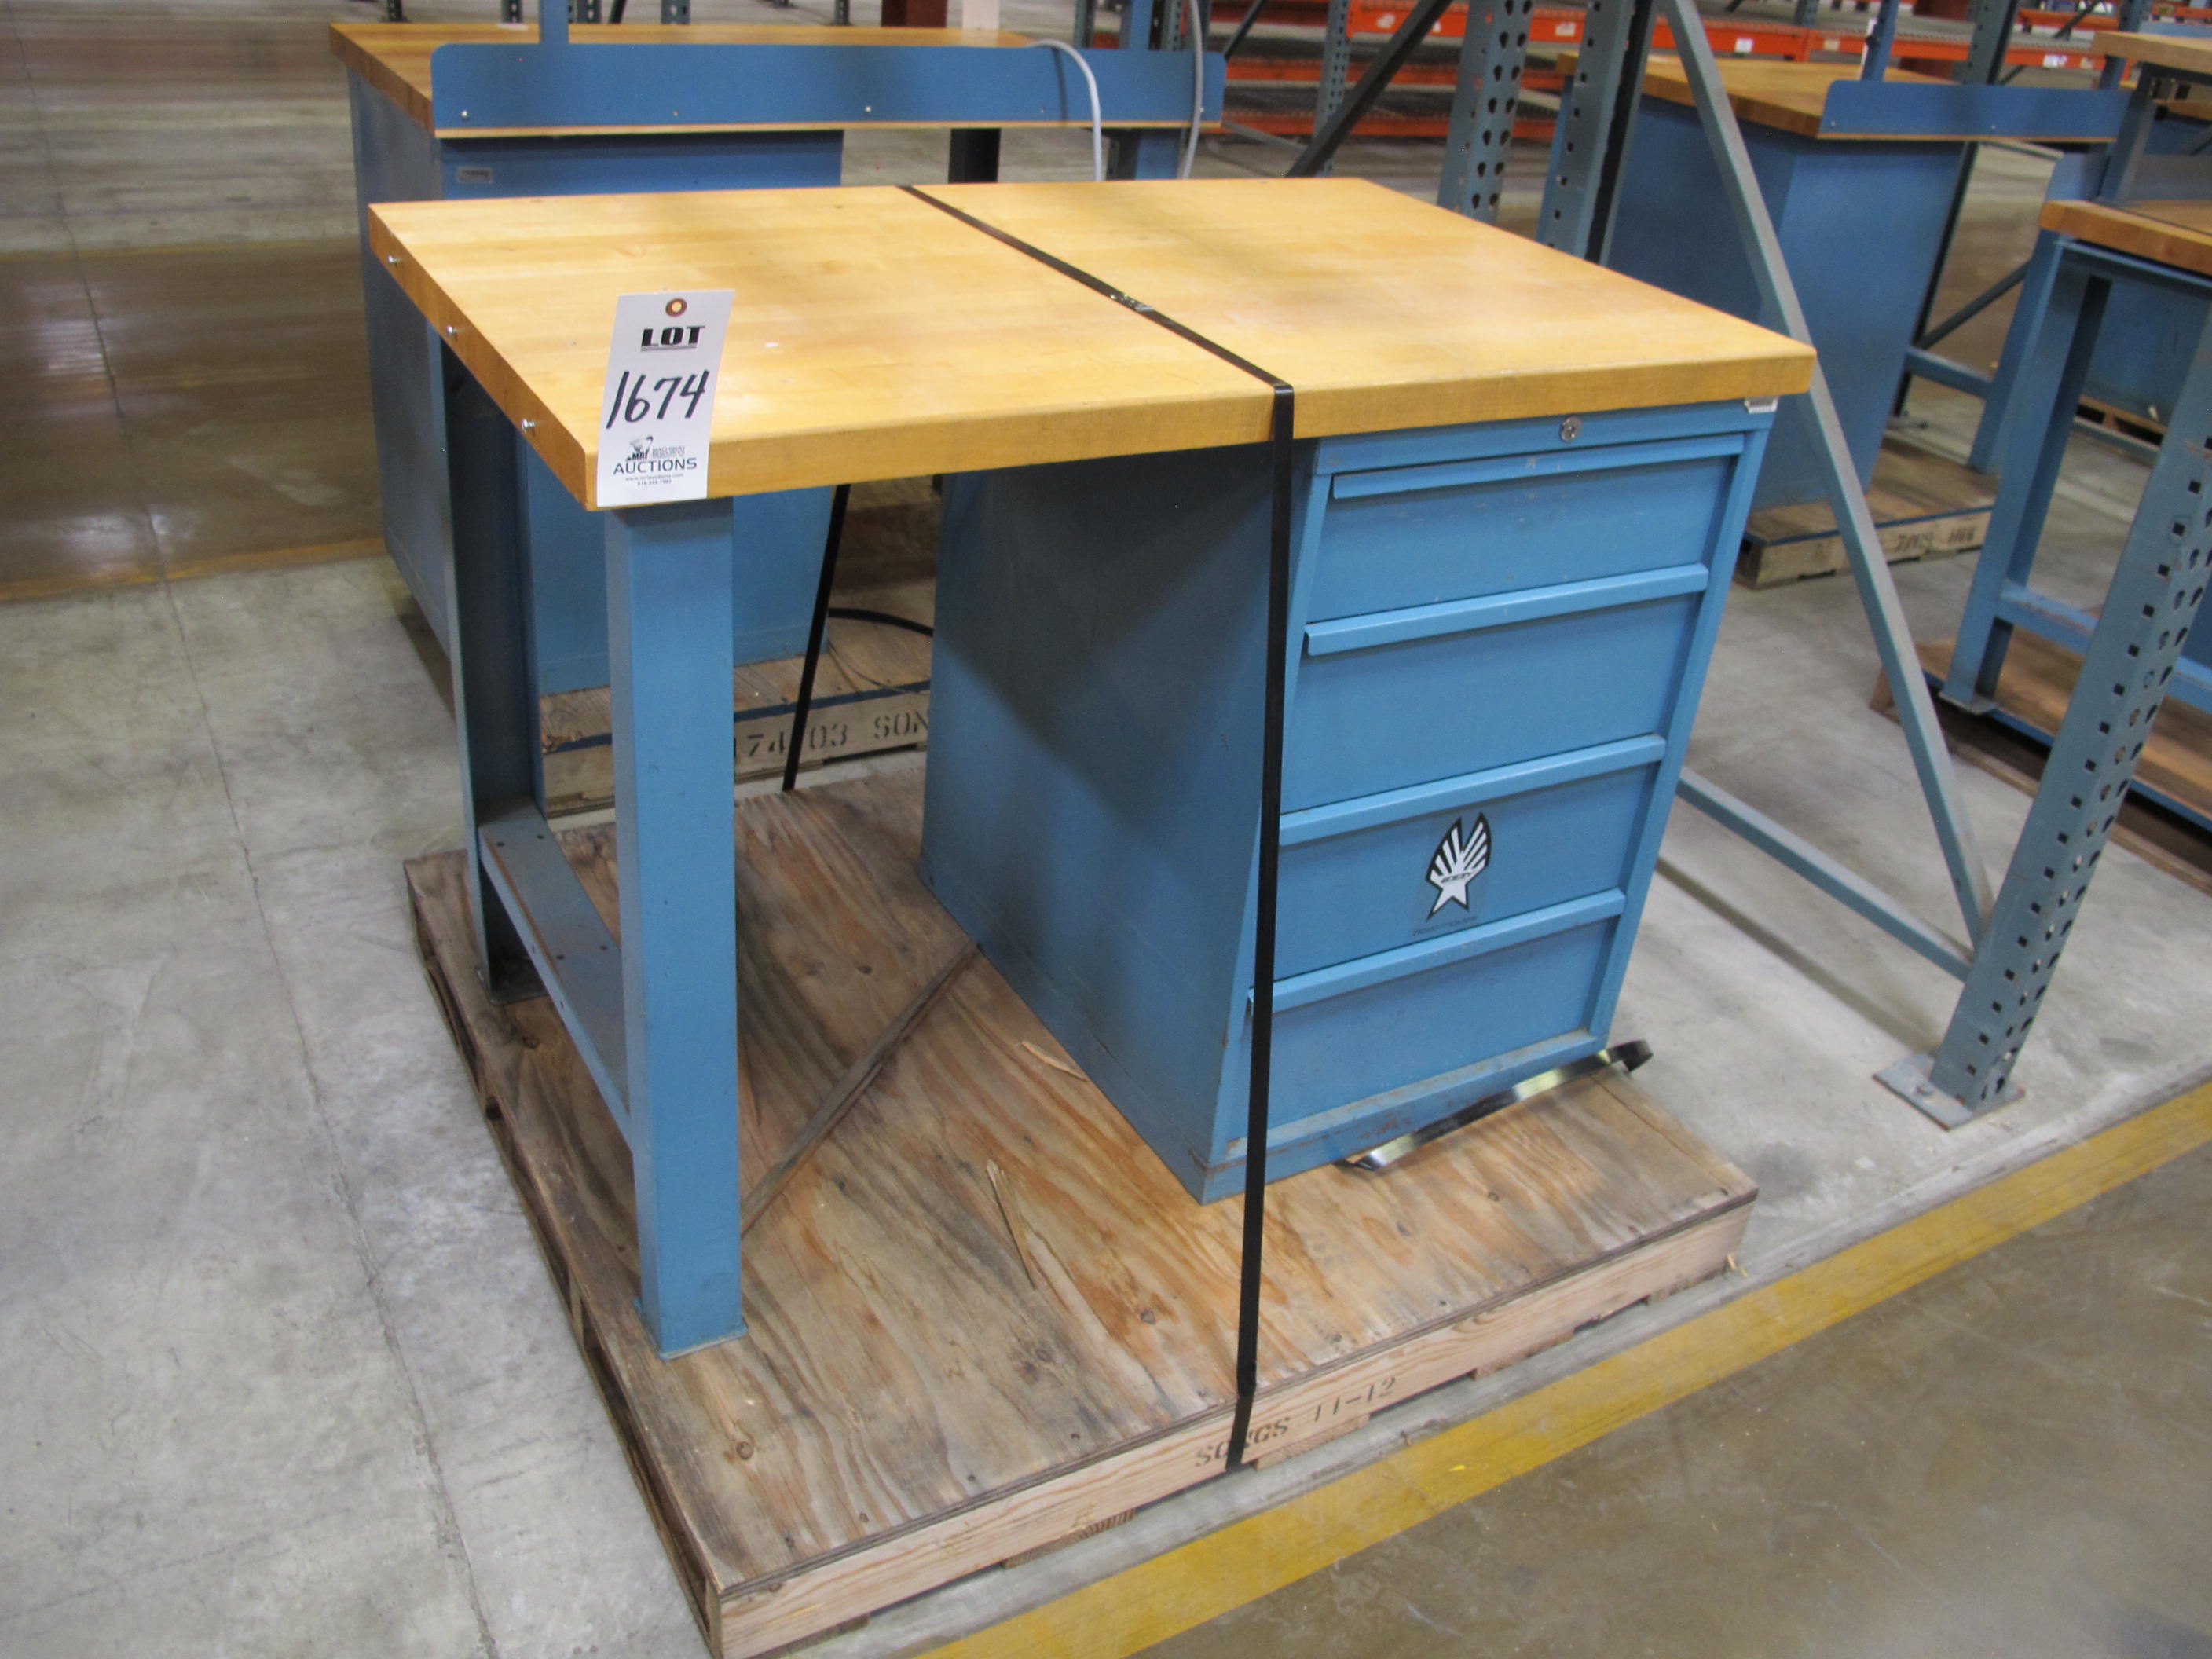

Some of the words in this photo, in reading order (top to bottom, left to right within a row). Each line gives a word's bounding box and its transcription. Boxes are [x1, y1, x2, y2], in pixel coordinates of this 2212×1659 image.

[640, 324, 705, 348] LOT
[606, 369, 710, 429] 1674
[613, 457, 698, 475] AUCTIONS
[1195, 1416, 1291, 1467] SOGS
[1314, 1377, 1396, 1423] 11-12
